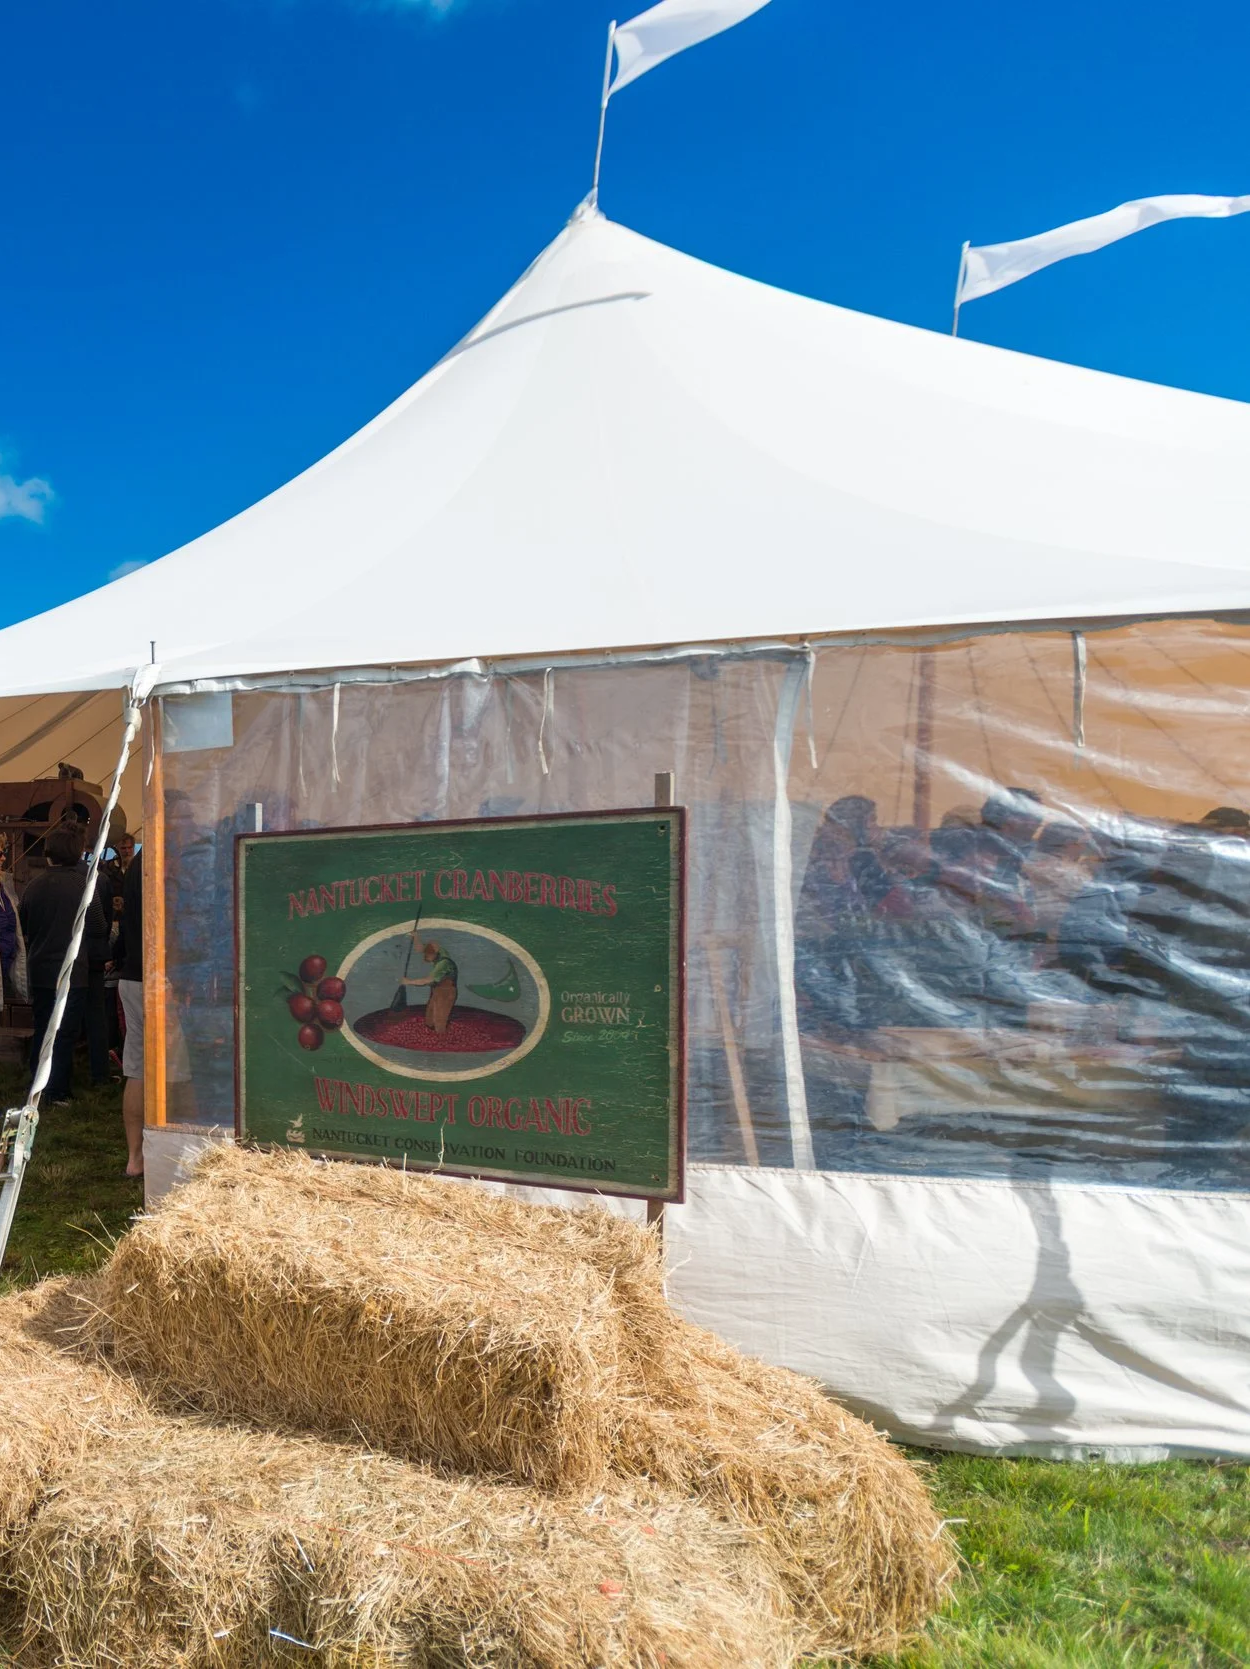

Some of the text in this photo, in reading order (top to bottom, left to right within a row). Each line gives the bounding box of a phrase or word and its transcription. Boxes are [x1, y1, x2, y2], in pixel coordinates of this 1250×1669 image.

[286, 869, 618, 921] NANTUCKET CRANBERRIES
[560, 990, 631, 1006] Organically
[561, 1005, 631, 1025] GROWN
[561, 1031, 593, 1043] Since
[313, 1077, 592, 1136] WINDSWEPT ORGANIC
[312, 1127, 617, 1172] NANTUCKET CONSERVATION FOUNDATION
